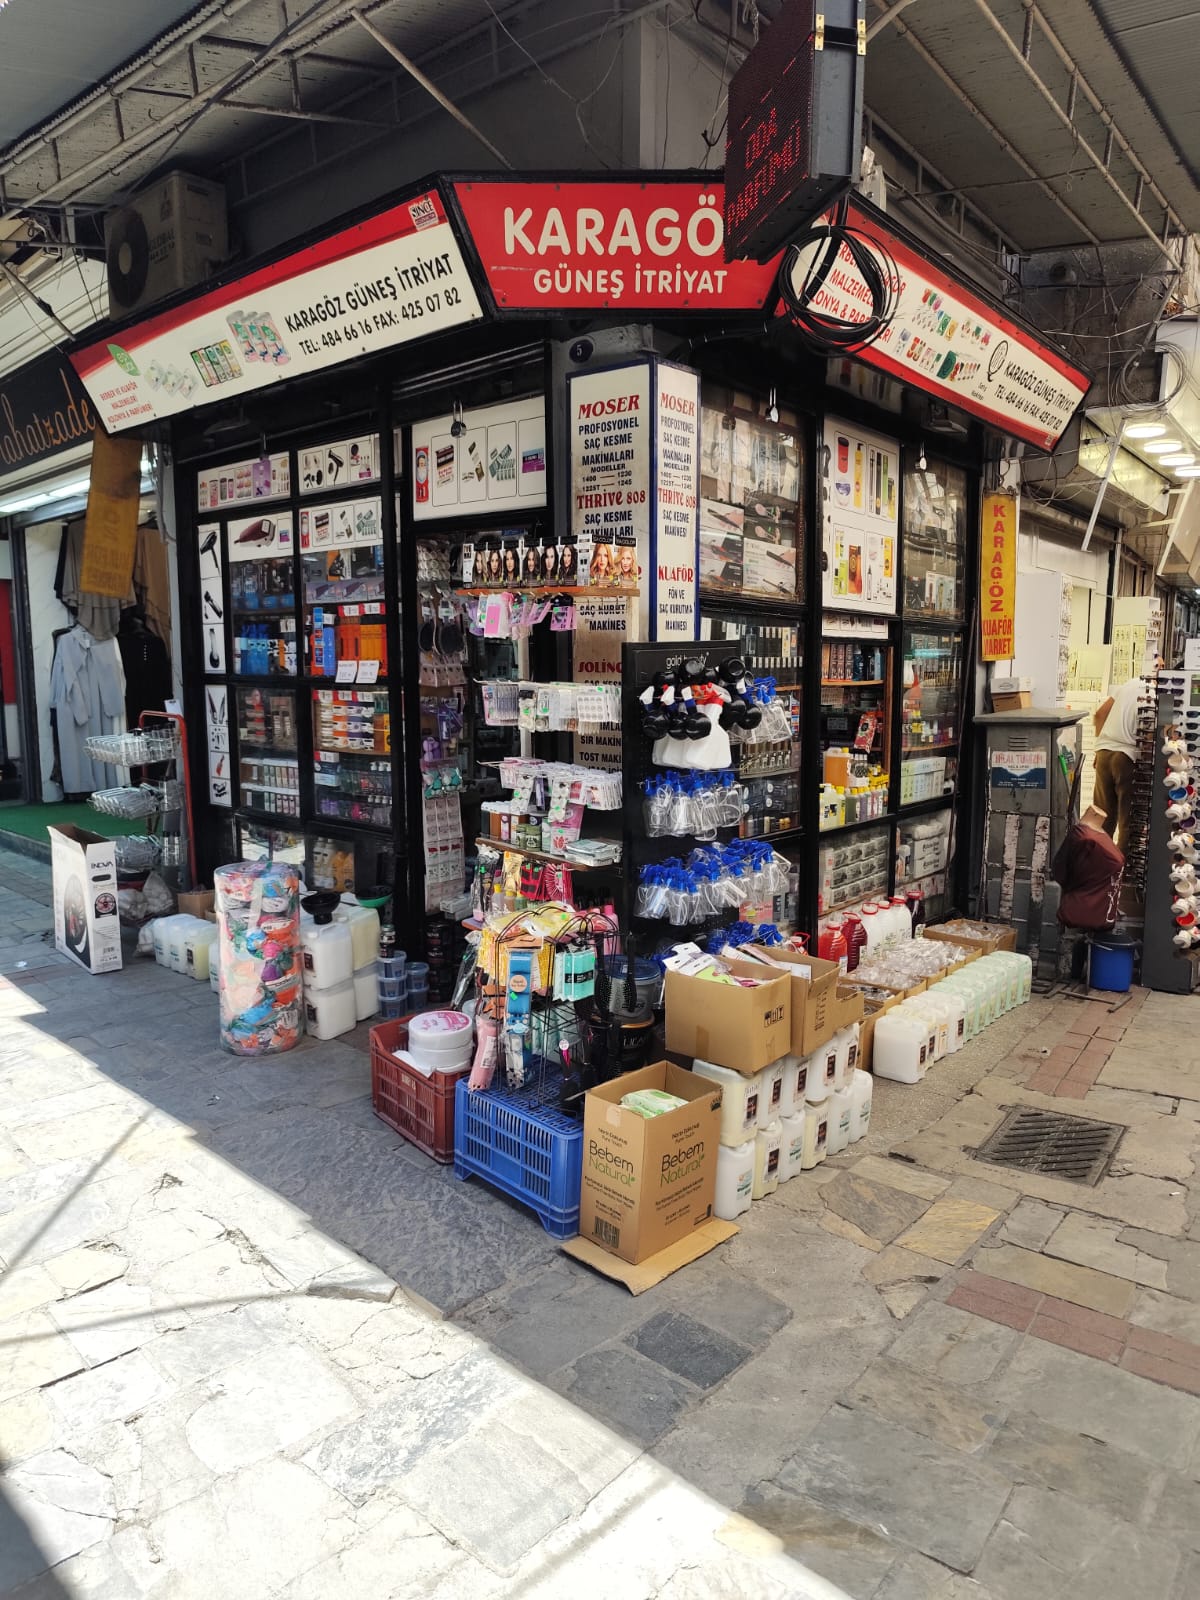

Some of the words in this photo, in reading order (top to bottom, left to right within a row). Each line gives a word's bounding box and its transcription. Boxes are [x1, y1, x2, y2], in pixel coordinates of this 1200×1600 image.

[745, 107, 777, 170] ODA
[727, 119, 800, 236] PARFÜMÜ
[504, 194, 724, 256] KARAGÖ
[533, 263, 624, 299] GÜNEŞ
[635, 263, 728, 294] İTRİYAT
[284, 295, 346, 333] KARAGÖZ
[345, 276, 398, 310] GÜNEŞ
[394, 254, 453, 292] İTRİYAT
[840, 304, 848, 319] &
[299, 339, 321, 356] TEL:
[321, 329, 342, 348] 484
[344, 324, 359, 341] 66
[357, 319, 373, 335] 16
[373, 310, 400, 331] FAX:
[401, 300, 424, 320] 425
[425, 293, 442, 313] 07
[443, 287, 462, 307] 82
[576, 344, 583, 357] 5
[1004, 361, 1037, 390] KARAGÖZ
[1033, 379, 1057, 405] GÜNEŞ
[578, 394, 640, 419] MOSER
[660, 392, 695, 416] MOSER
[1006, 391, 1018, 403] 484
[1015, 397, 1025, 409] 66
[1023, 401, 1031, 412] 16
[1039, 410, 1050, 423] 425
[1047, 415, 1056, 426] 07
[1053, 419, 1062, 430] 82
[0, 367, 96, 465] ahatzade
[661, 415, 695, 434] PROFOSYONEL
[578, 417, 639, 436] PROFOSYONEL
[584, 437, 600, 451] SAÇ
[603, 433, 632, 448] KESME
[663, 432, 673, 446] SAÇ
[674, 434, 690, 448] KESME
[582, 449, 634, 466] MAKİNALARI
[663, 448, 691, 465] MAKİNALARI
[591, 463, 626, 473] MODELLER
[617, 470, 632, 478] 1230
[664, 461, 690, 472] MODELLER
[617, 479, 632, 487] 1245
[626, 490, 646, 504] 808
[686, 496, 696, 509] 808
[584, 514, 601, 525] SAÇ
[604, 510, 632, 523] KESME
[663, 510, 672, 522] SAÇ
[674, 511, 689, 523] KESME
[988, 504, 1006, 612] KARAGÖZ
[668, 587, 678, 599] FÖN
[679, 589, 685, 599] VE
[580, 604, 596, 617] SAÇ
[659, 604, 668, 615] SAÇ
[670, 604, 692, 614] KURUTMA
[982, 614, 1012, 636] KUAFÖR
[983, 638, 1011, 656] MARKET
[666, 654, 682, 670] gold
[579, 752, 599, 761] TOST
[589, 1140, 634, 1173] Bebem
[661, 1141, 704, 1173] Bebem
[589, 1156, 632, 1188] Natural
[660, 1157, 703, 1188] Natural
